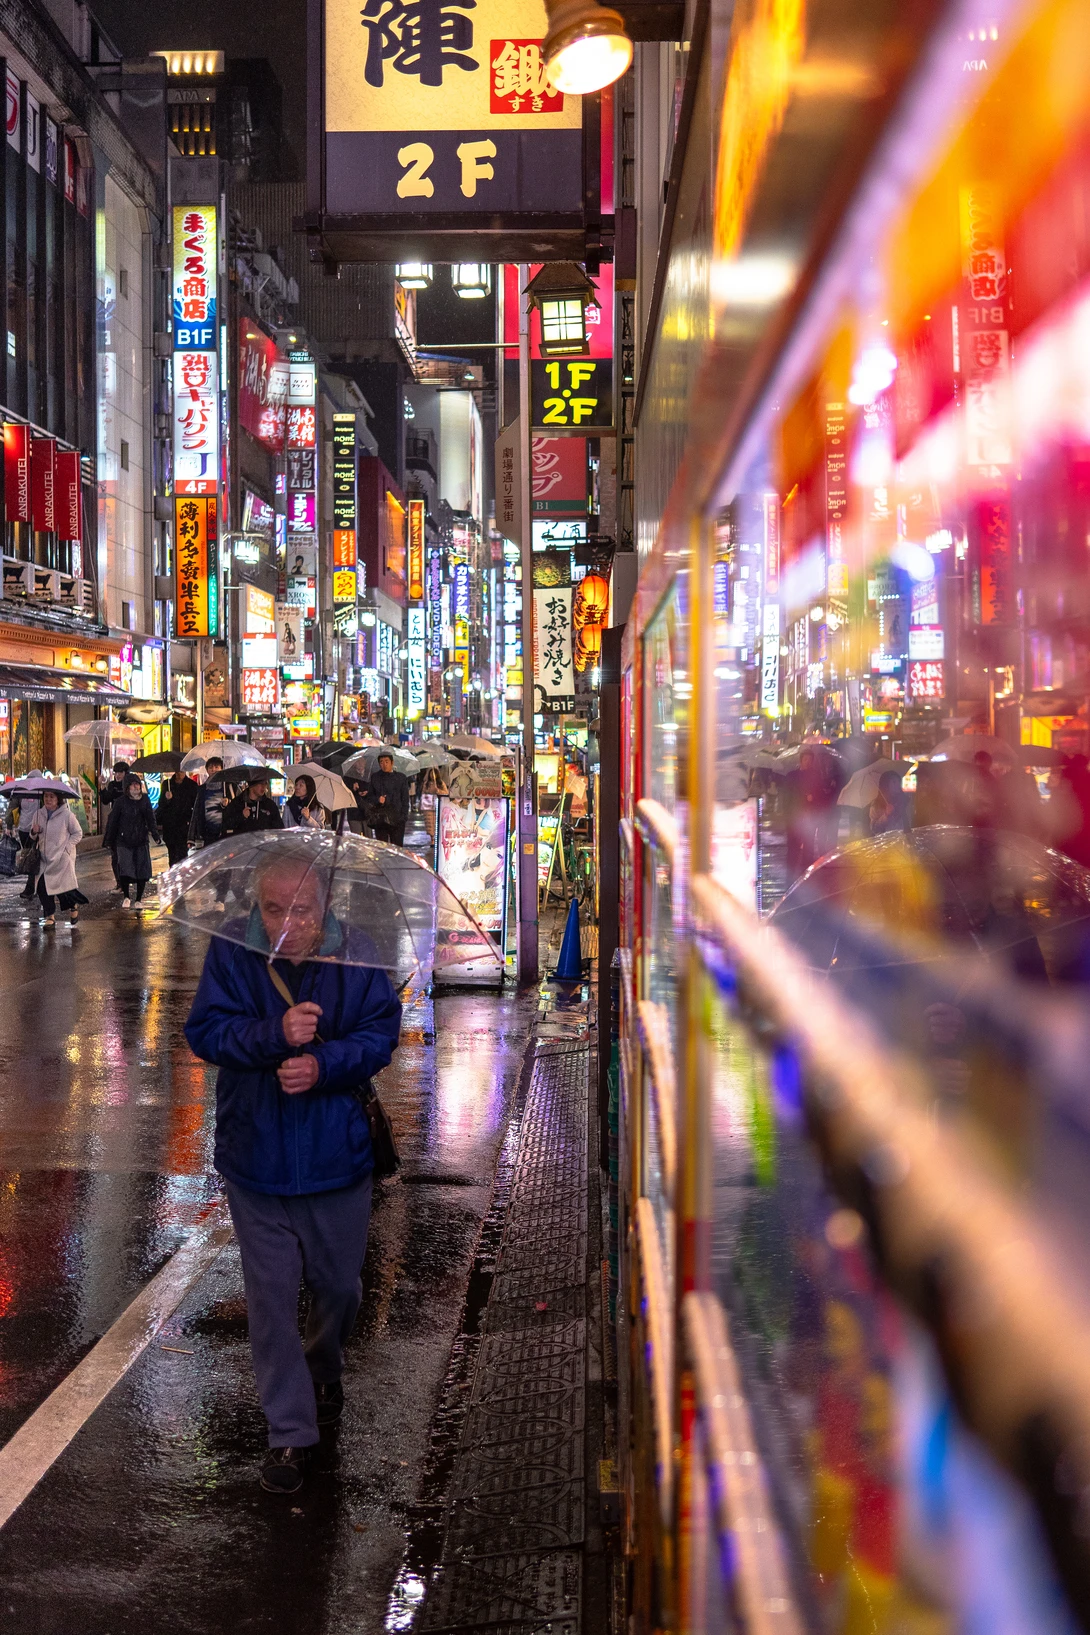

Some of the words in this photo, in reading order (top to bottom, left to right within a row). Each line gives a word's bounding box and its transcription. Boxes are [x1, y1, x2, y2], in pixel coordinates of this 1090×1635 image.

[361, 0, 480, 87] 陣
[508, 96, 544, 112] すき
[182, 213, 206, 320] まぐろ商店
[177, 329, 213, 345] B1F
[542, 398, 598, 424] 2F
[18, 458, 27, 519] ANRAKUTEI
[185, 481, 207, 494] 4F
[302, 451, 312, 489] レンタル
[502, 447, 514, 522] 劇場通り一番街
[45, 471, 53, 529] ANRAKUTEI
[69, 483, 78, 538] ANRAKUTEI
[536, 502, 549, 510] B1
[542, 597, 571, 686] お好み焼き
[411, 658, 422, 703] にいむら
[552, 702, 574, 711] B1F
